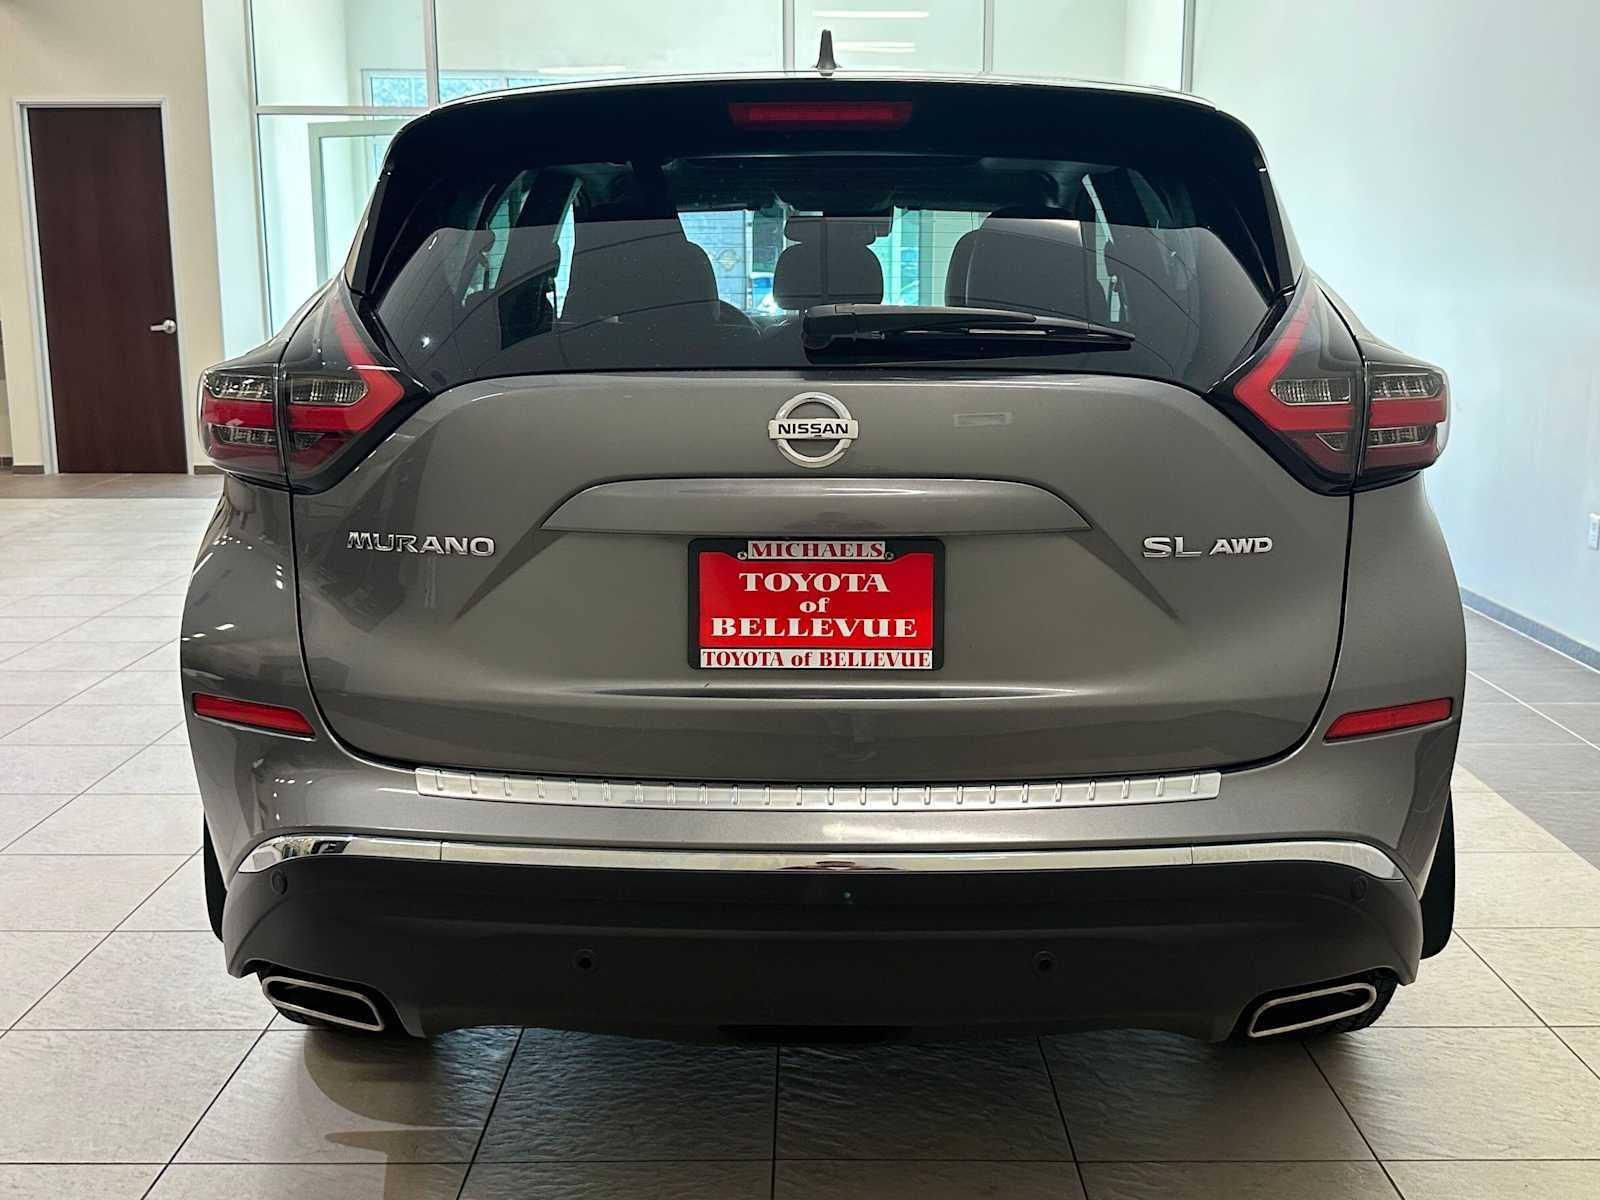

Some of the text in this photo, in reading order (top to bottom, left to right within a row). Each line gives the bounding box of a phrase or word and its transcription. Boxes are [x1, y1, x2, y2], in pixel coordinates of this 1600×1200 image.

[777, 423, 849, 435] NISSAN
[346, 531, 495, 557] MURANO
[749, 542, 883, 558] MICHAELS
[1143, 536, 1273, 558] SL AWD
[739, 572, 890, 593] TOYOTA
[799, 597, 830, 613] of
[711, 617, 917, 638] BELLEVUE
[702, 651, 931, 668] TOYOTA of BELLEVUE
